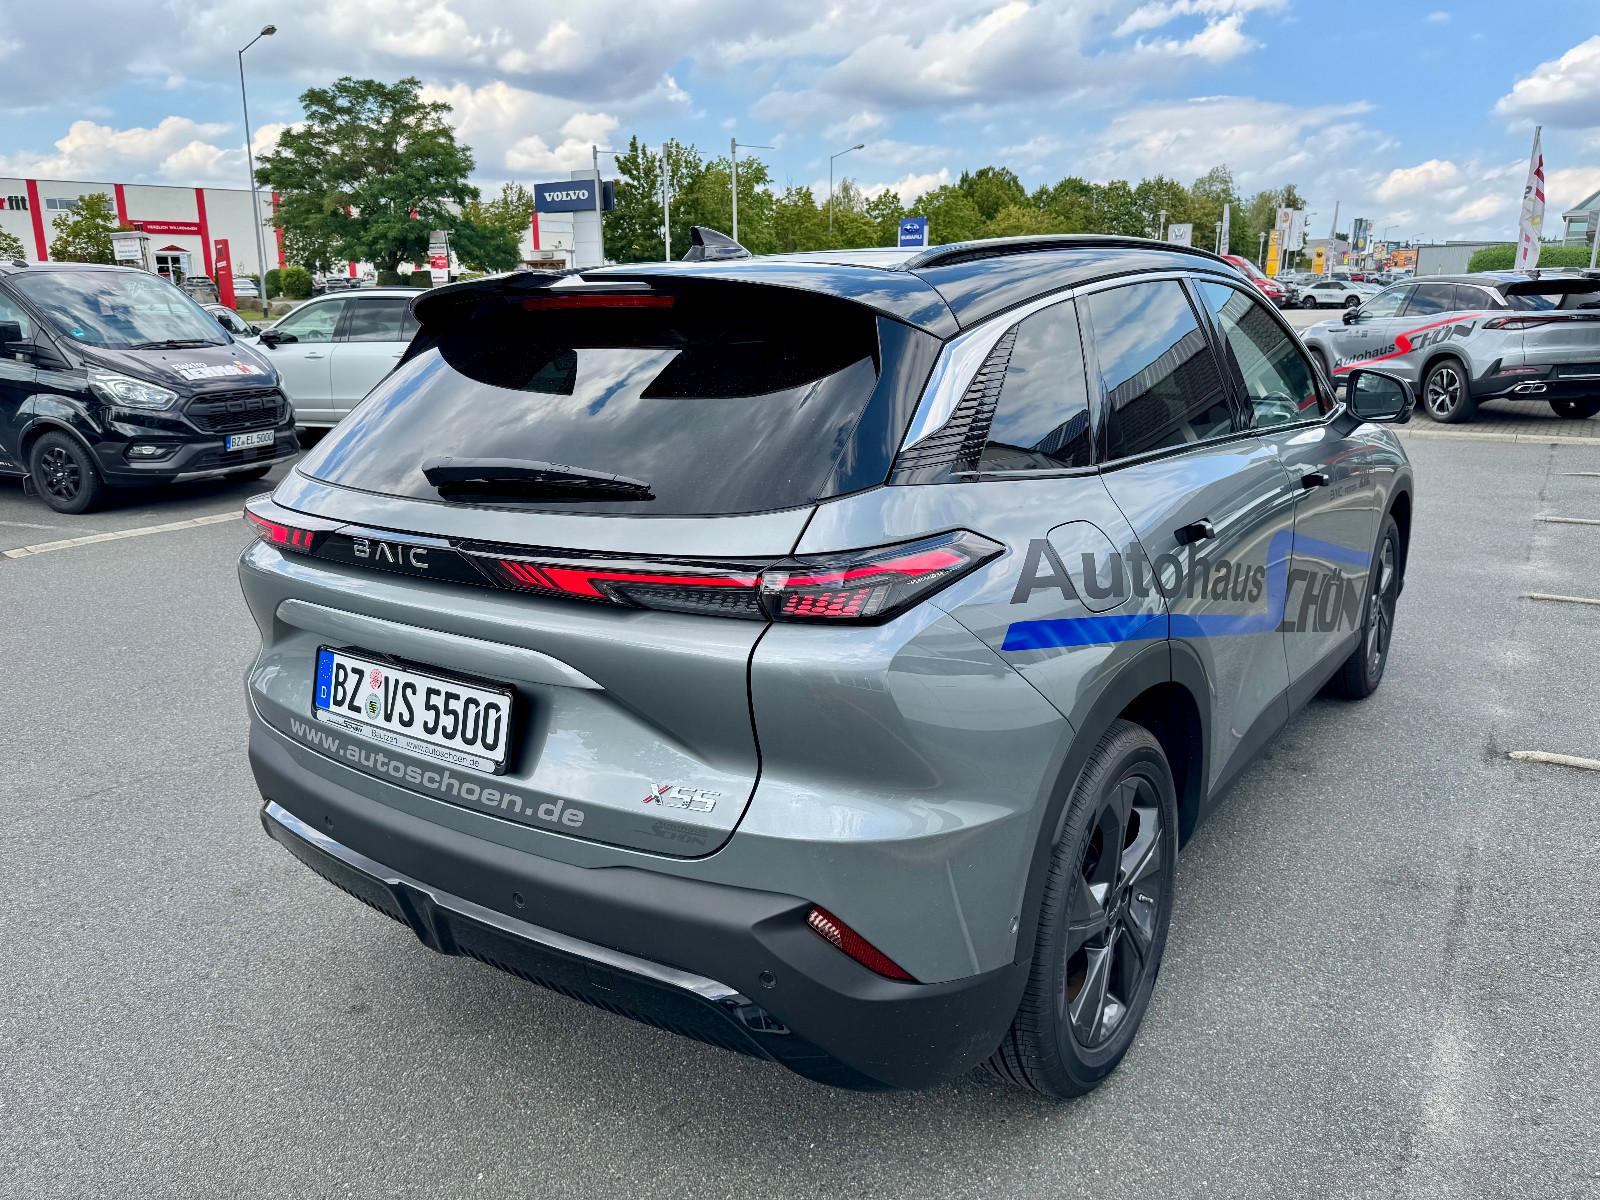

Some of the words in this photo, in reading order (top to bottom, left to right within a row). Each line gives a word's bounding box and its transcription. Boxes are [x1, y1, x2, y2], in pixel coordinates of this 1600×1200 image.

[544, 190, 589, 202] VOLVO
[1334, 344, 1396, 369] Autohaus
[231, 437, 241, 448] BZ
[246, 435, 256, 445] EL
[353, 537, 429, 569] BAIC
[1010, 538, 1266, 604] Autohaus
[320, 686, 328, 699] D
[332, 662, 365, 714] BZ
[383, 675, 418, 728] VS
[422, 687, 502, 752] 5500
[406, 741, 480, 768] www.autoschoen.de
[289, 716, 586, 828] www.autoschoen.de
[641, 783, 722, 813] X55
